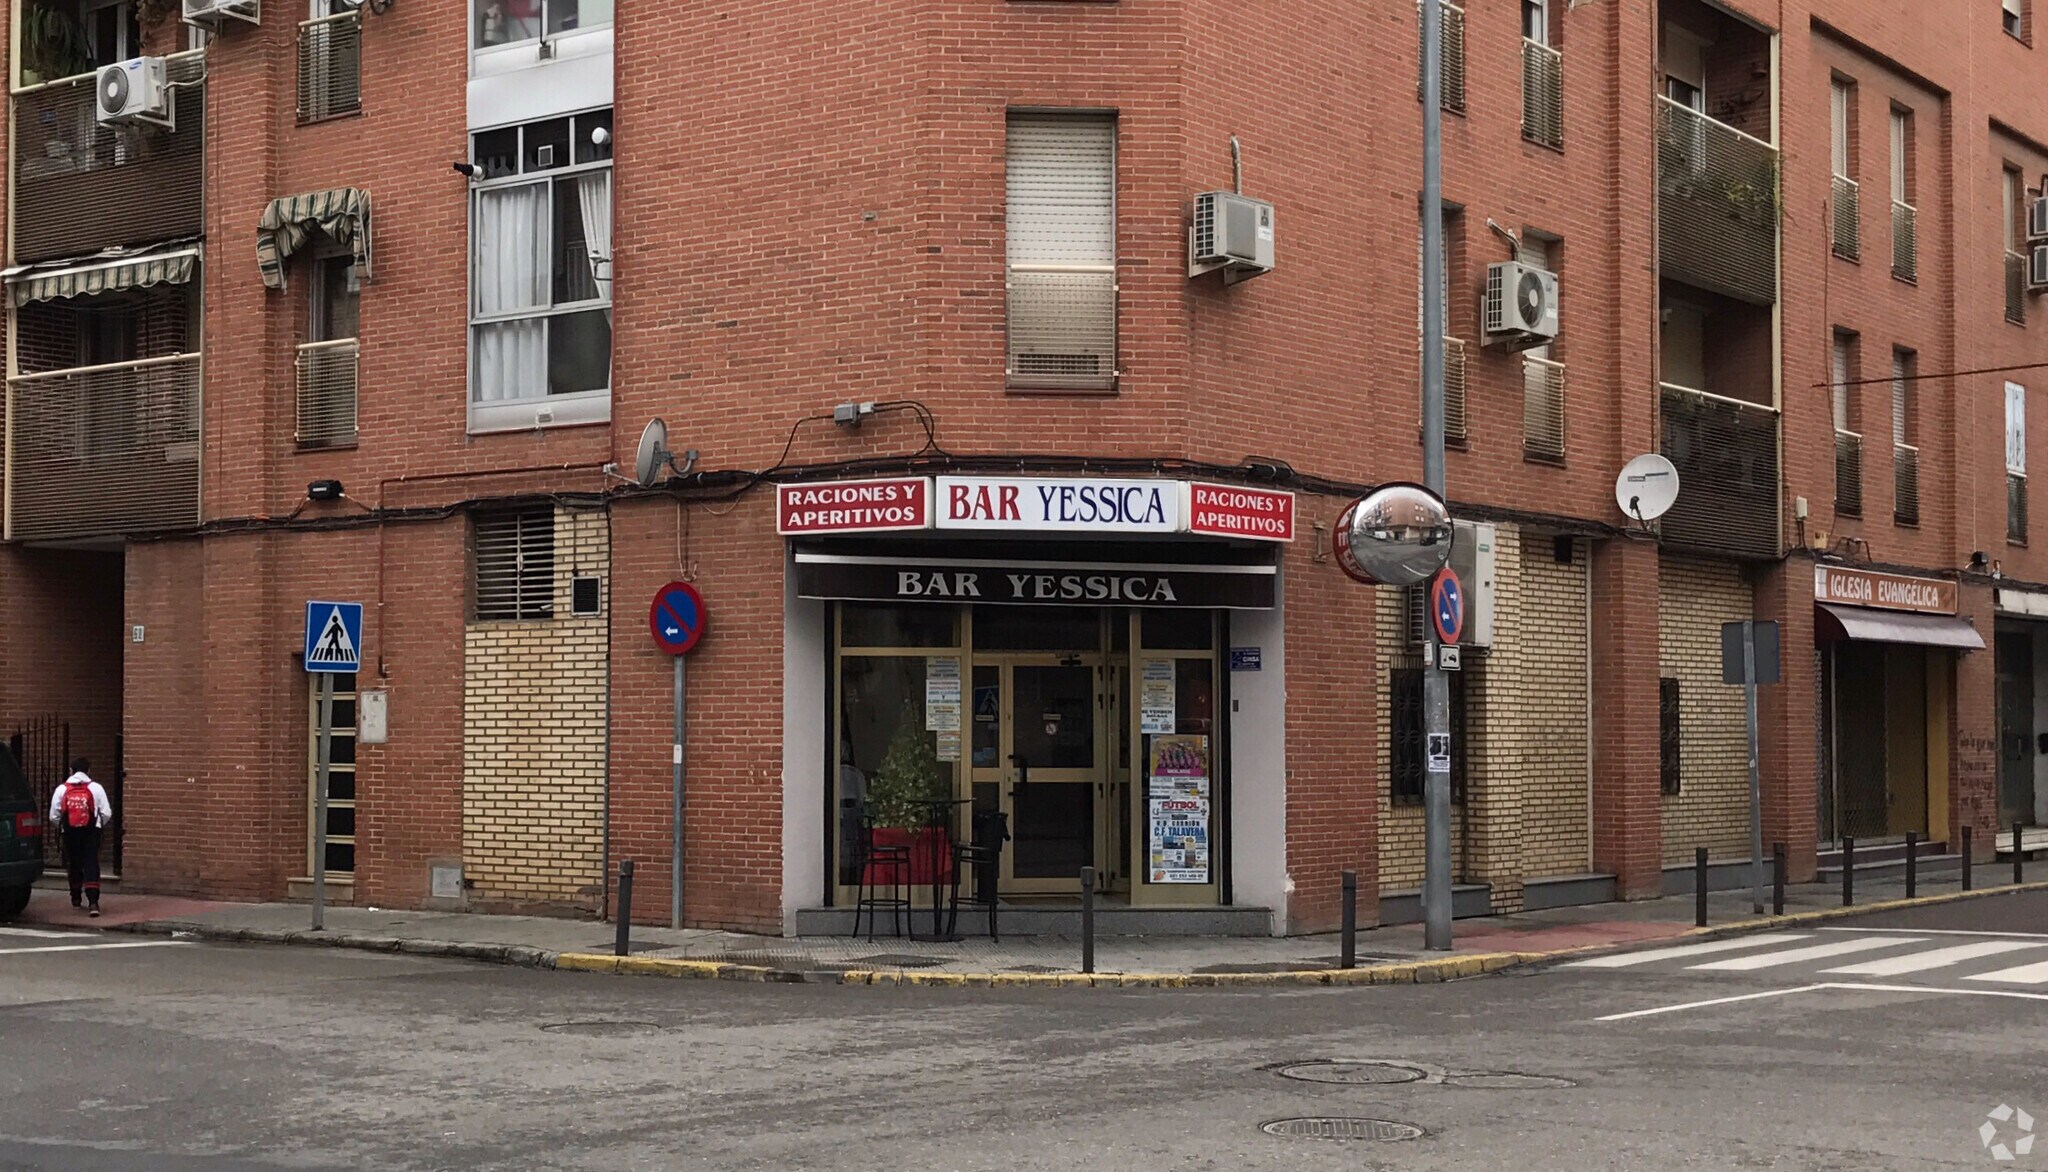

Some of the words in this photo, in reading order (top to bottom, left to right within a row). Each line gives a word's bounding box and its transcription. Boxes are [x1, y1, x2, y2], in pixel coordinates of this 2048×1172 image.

[788, 485, 897, 506] RACIONES
[903, 484, 916, 500] Y
[948, 485, 1021, 520] BAR
[1037, 486, 1166, 523] YESSICA
[1196, 489, 1274, 512] RACIONES
[1277, 498, 1287, 513] Y
[787, 506, 915, 527] APERITIVOS
[1196, 511, 1286, 534] APERITIVOS
[897, 571, 982, 597] BAR
[1006, 574, 1178, 601] YESSICA
[1831, 574, 1872, 600] IGLESIA
[1878, 580, 1939, 607] EVANGÉLICA
[1168, 827, 1205, 837] TALAVERA
